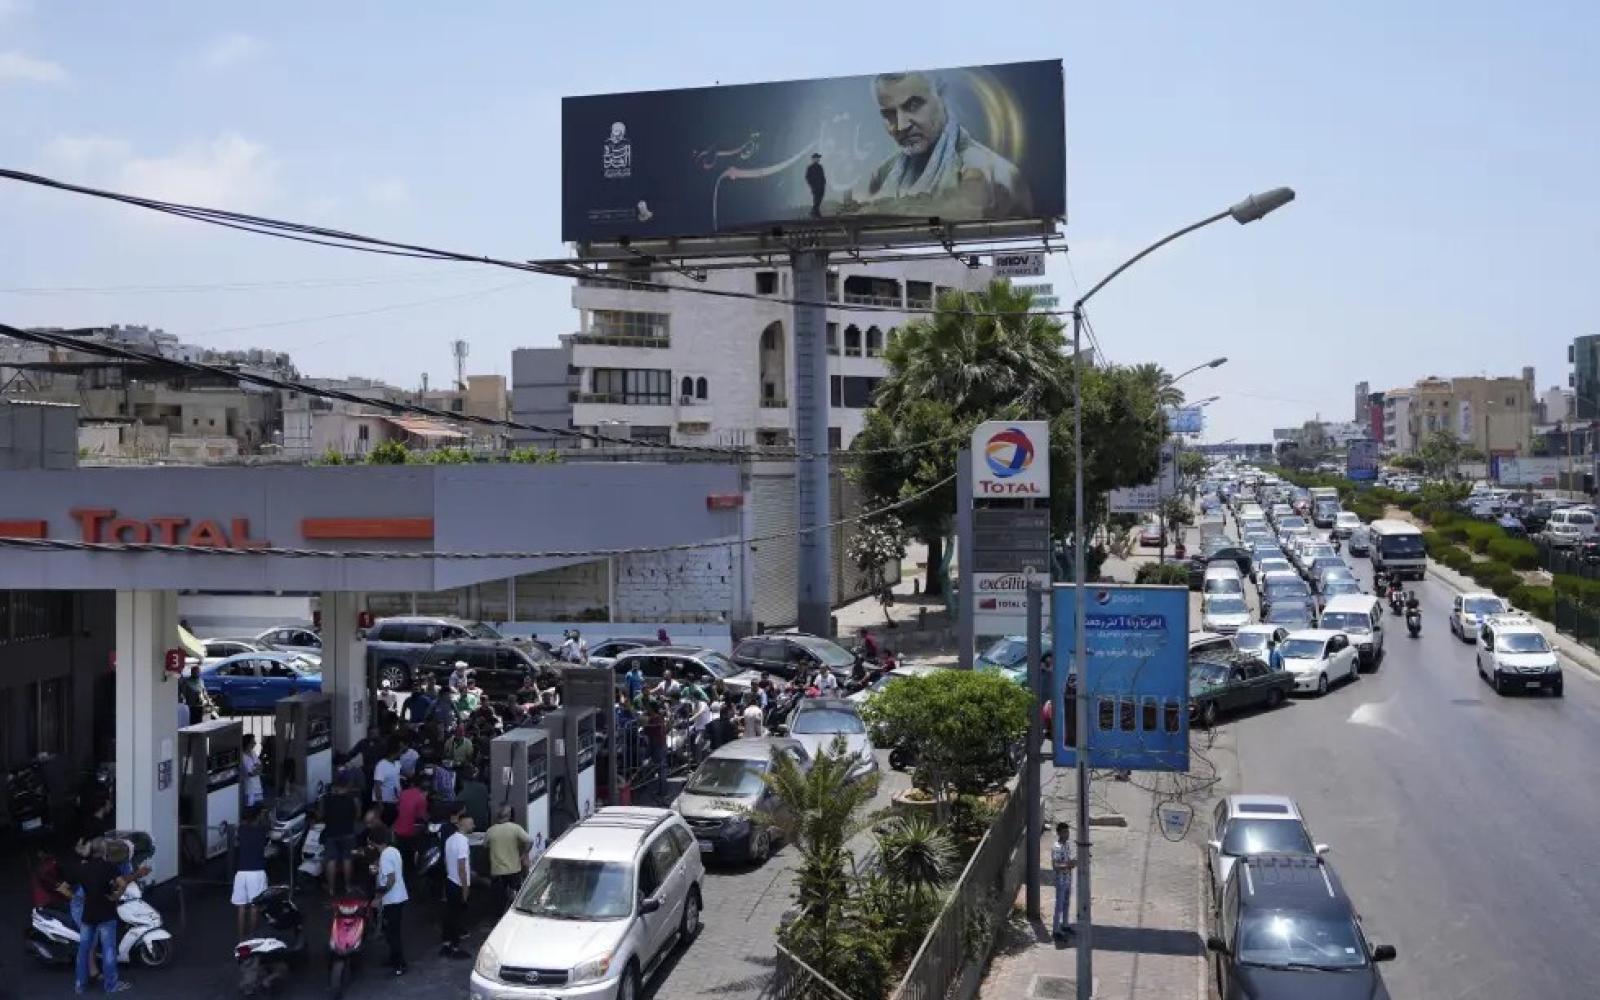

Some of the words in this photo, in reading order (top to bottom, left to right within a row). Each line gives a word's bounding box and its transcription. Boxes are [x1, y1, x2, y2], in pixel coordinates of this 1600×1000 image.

[979, 480, 1041, 494] TOTAL
[70, 507, 271, 550] TOTAL
[998, 600, 1020, 608] TOTAL
[171, 652, 179, 665] 3
